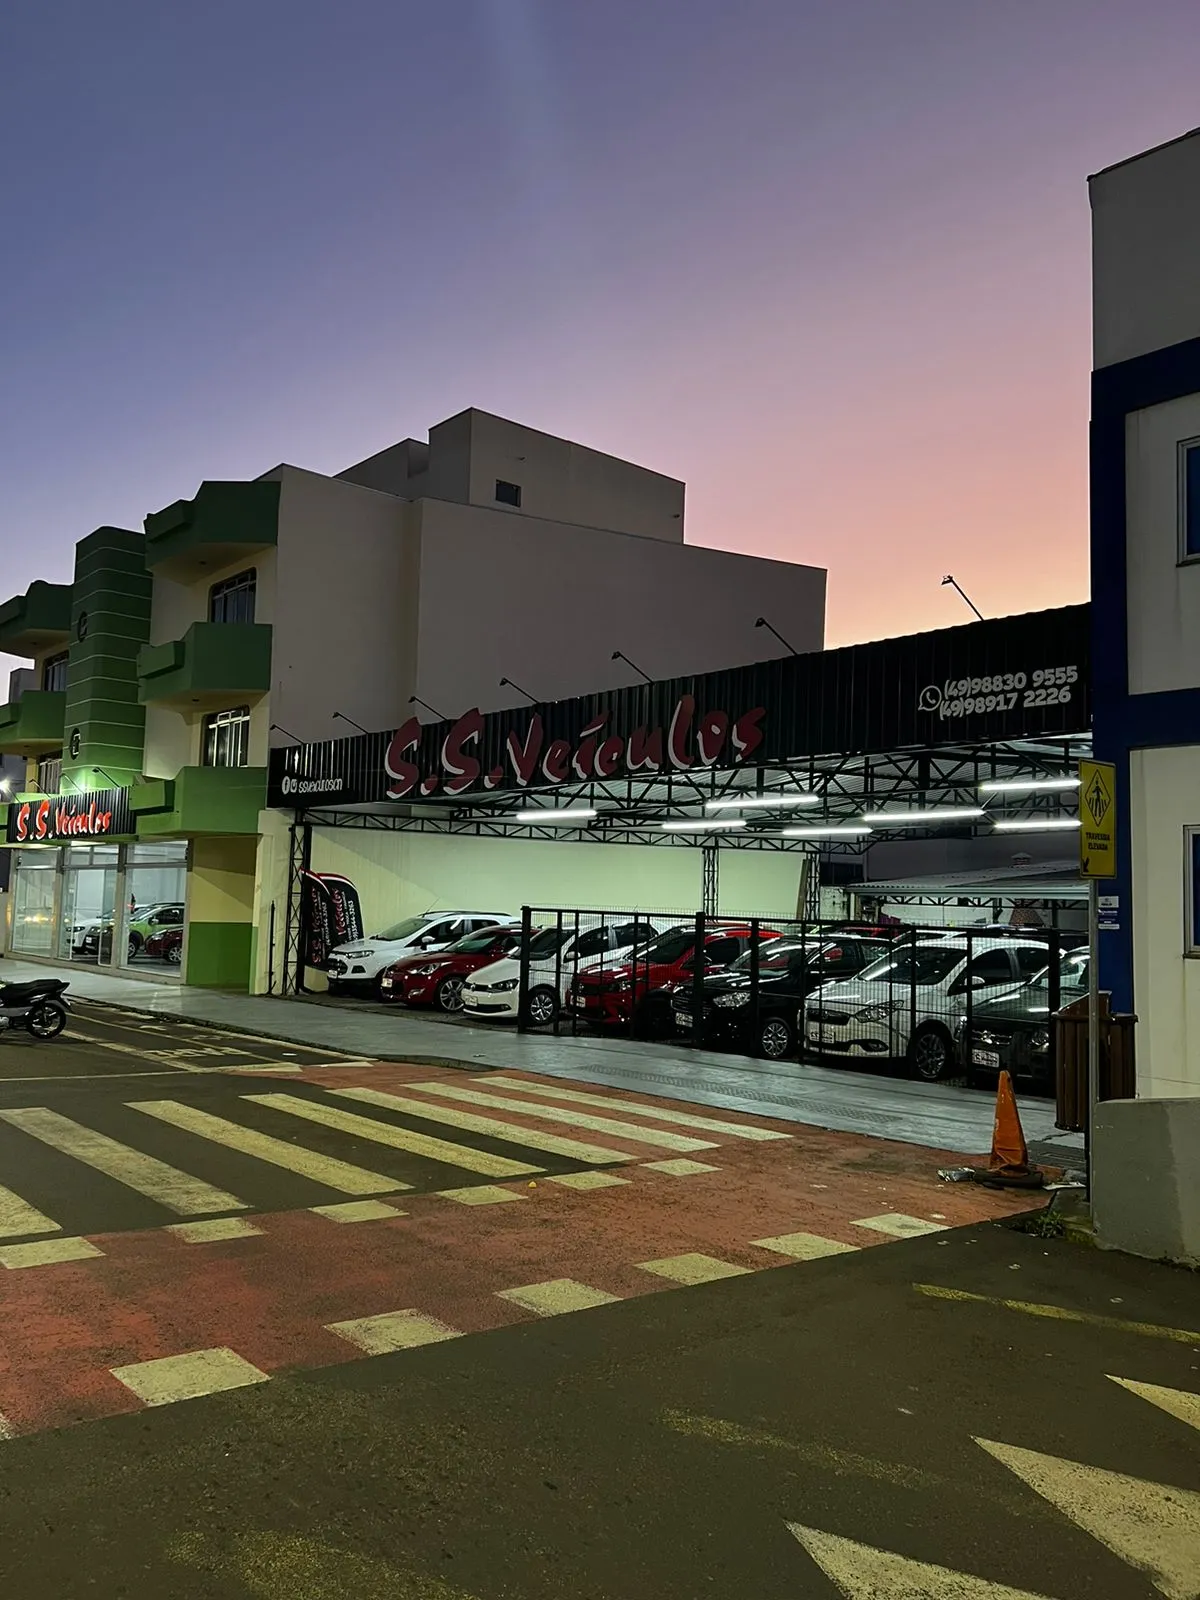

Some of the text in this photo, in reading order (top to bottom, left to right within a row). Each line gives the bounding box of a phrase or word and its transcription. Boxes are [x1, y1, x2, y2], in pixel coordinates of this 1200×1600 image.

[944, 665, 1078, 700] (49)98830 9555
[939, 685, 1072, 721] (49)98917 2226
